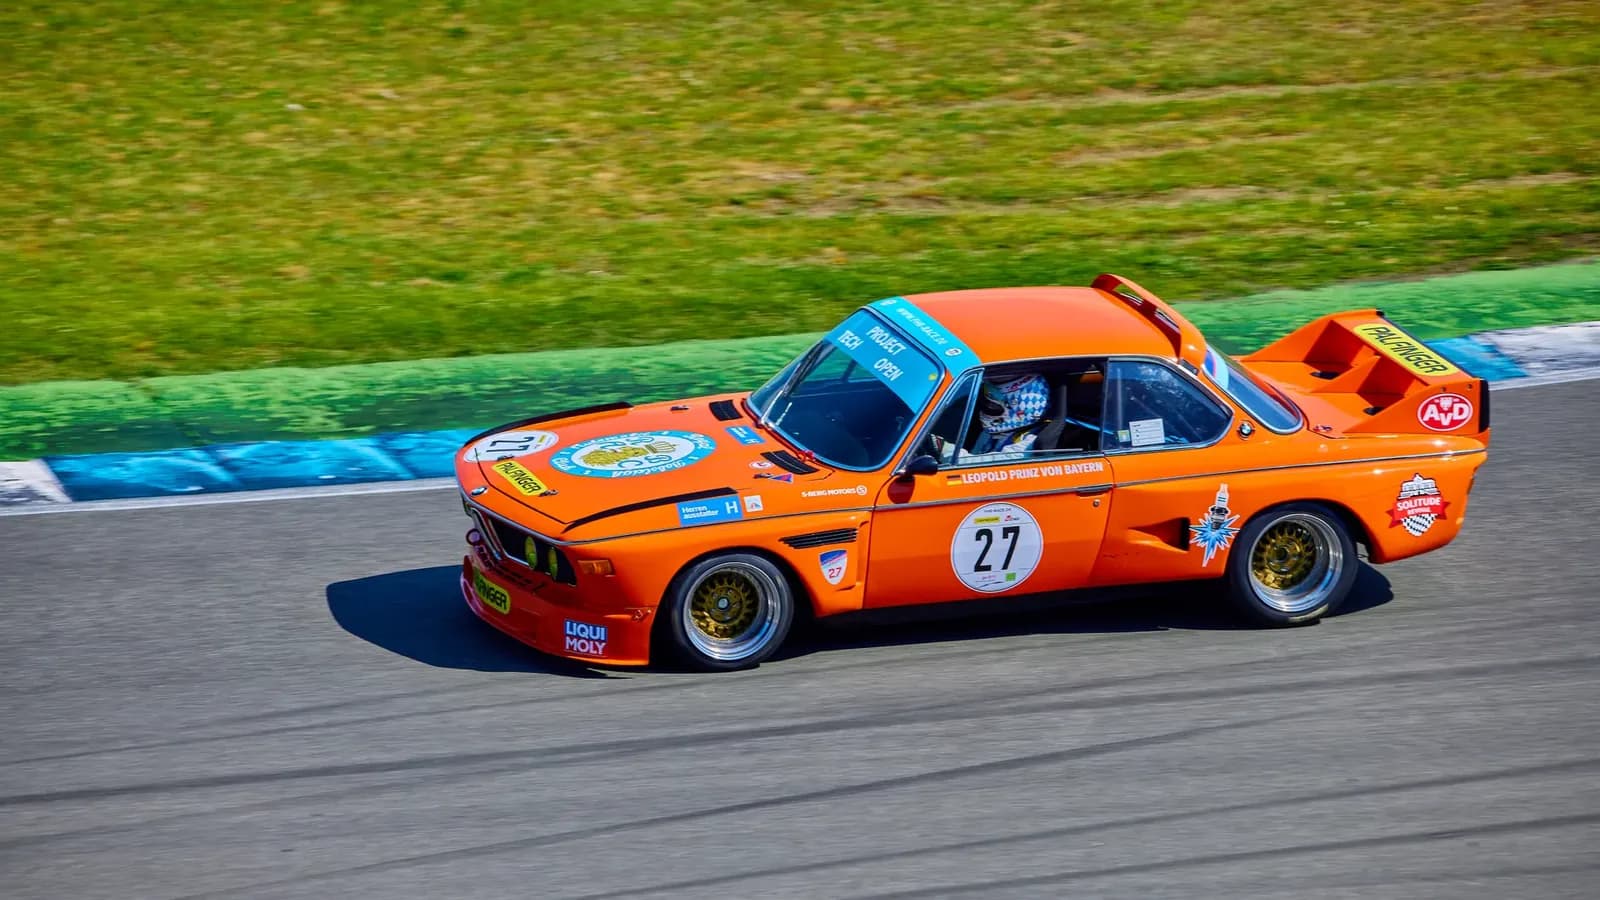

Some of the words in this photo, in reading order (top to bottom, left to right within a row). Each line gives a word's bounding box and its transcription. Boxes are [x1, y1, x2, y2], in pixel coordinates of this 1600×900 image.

[866, 326, 907, 355] PROJECT
[1362, 326, 1449, 374] PALFINGER
[837, 329, 865, 351] TECH
[873, 358, 904, 381] OPEN
[496, 461, 542, 494] PALFINGER
[962, 470, 1008, 484] LEOPOLD
[1010, 467, 1040, 480] PRINZ
[1040, 466, 1063, 477] VON
[1064, 462, 1104, 475] BAYERN
[725, 501, 739, 514] H
[1396, 497, 1441, 511] SOLITUDE
[974, 526, 1020, 572] 27
[829, 567, 842, 579] 27
[566, 621, 606, 640] LIQUI
[566, 636, 606, 655] MOLY
